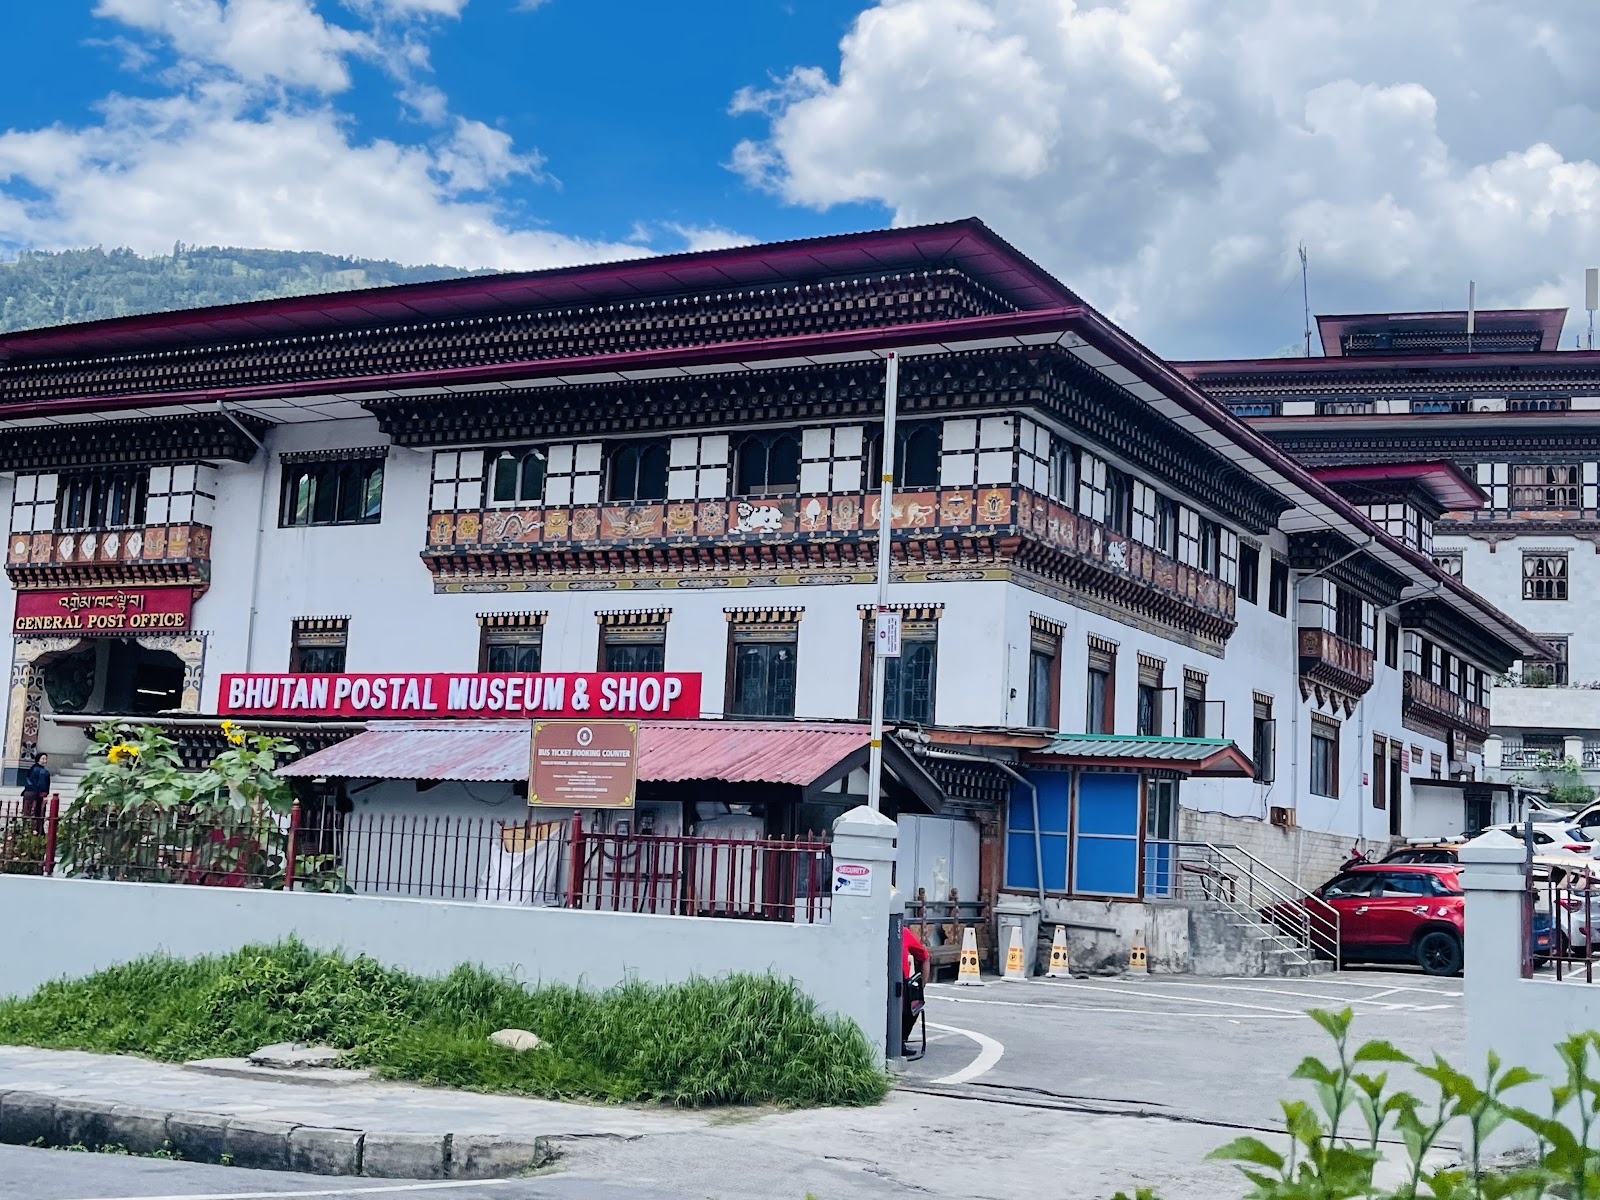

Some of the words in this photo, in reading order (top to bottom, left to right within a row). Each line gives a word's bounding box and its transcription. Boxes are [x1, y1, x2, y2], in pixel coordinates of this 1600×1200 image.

[15, 615, 82, 630] GENERAL
[87, 614, 126, 628] POST
[129, 612, 185, 628] OFFICE
[228, 677, 330, 709] BHUTAN
[333, 677, 438, 710] POSTAL
[447, 677, 566, 711] MUSEUM
[571, 677, 591, 711] &
[599, 677, 682, 712] SHOP
[538, 748, 550, 756] BUS
[551, 749, 571, 757] TICKET
[572, 749, 600, 757] BOOKING
[602, 749, 631, 758] COUNTER
[838, 866, 867, 875] SECURITY
